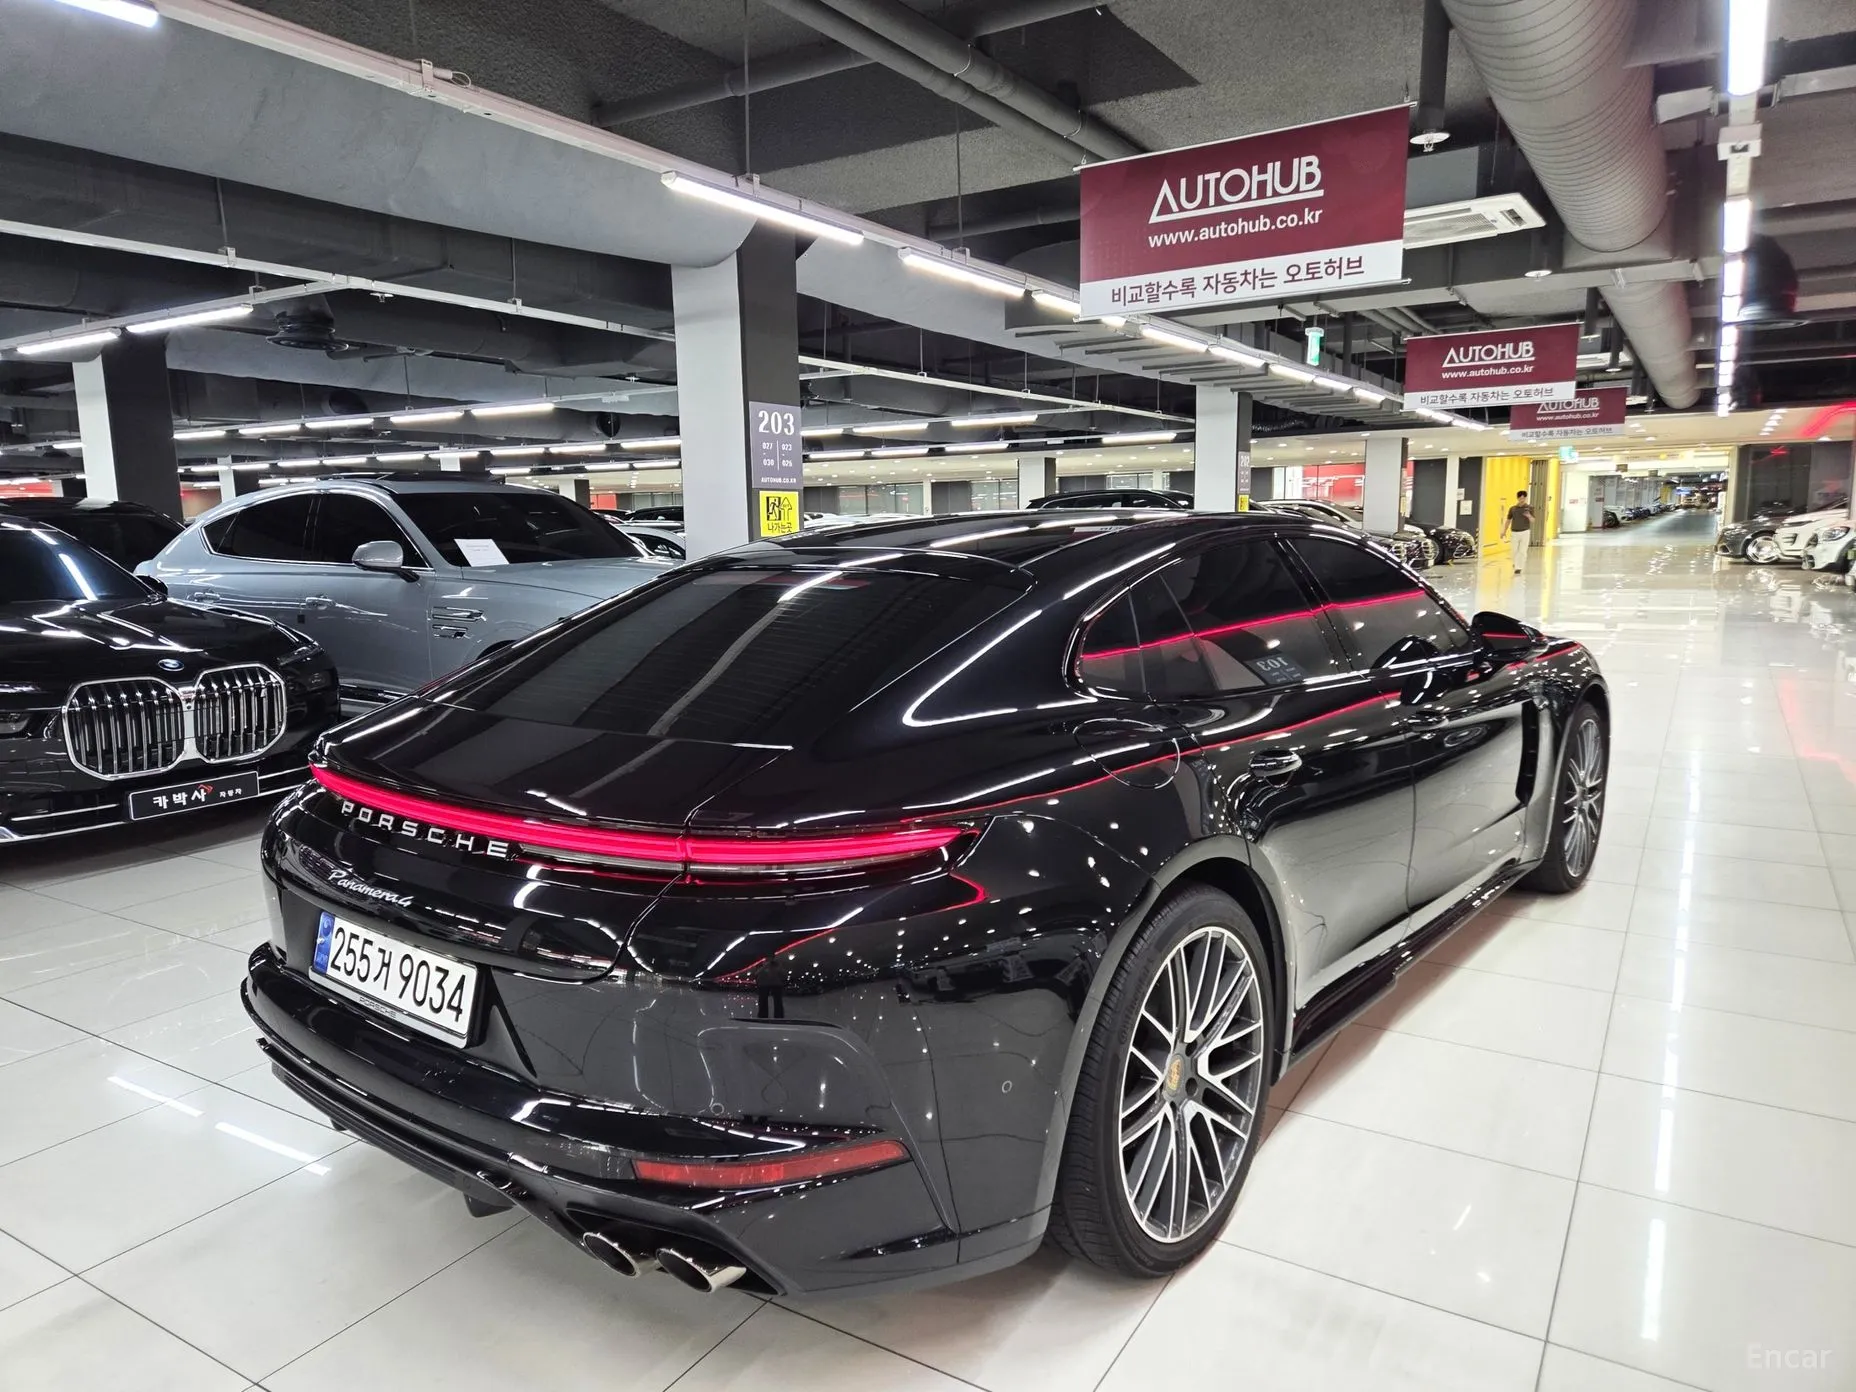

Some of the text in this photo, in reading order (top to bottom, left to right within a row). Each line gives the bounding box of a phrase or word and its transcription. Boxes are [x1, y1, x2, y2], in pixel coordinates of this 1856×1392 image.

[1148, 154, 1324, 224] AUTOHUB
[1148, 207, 1323, 248] www.autohub.co.kr
[1111, 255, 1365, 307] 비교할수록 자동차는 오토허브
[1442, 341, 1536, 368] AUTOHUB
[1441, 364, 1535, 380] www.autohub.co.kr
[1420, 386, 1554, 406] 비교할수록 자동차는 오토허브
[758, 410, 795, 436] 203
[762, 441, 792, 451] 027 023
[767, 522, 793, 533] 나가는곳
[341, 800, 509, 858] PORSCHE
[330, 927, 467, 1023] 255거 9034
[358, 996, 397, 1019] PORSCHE
